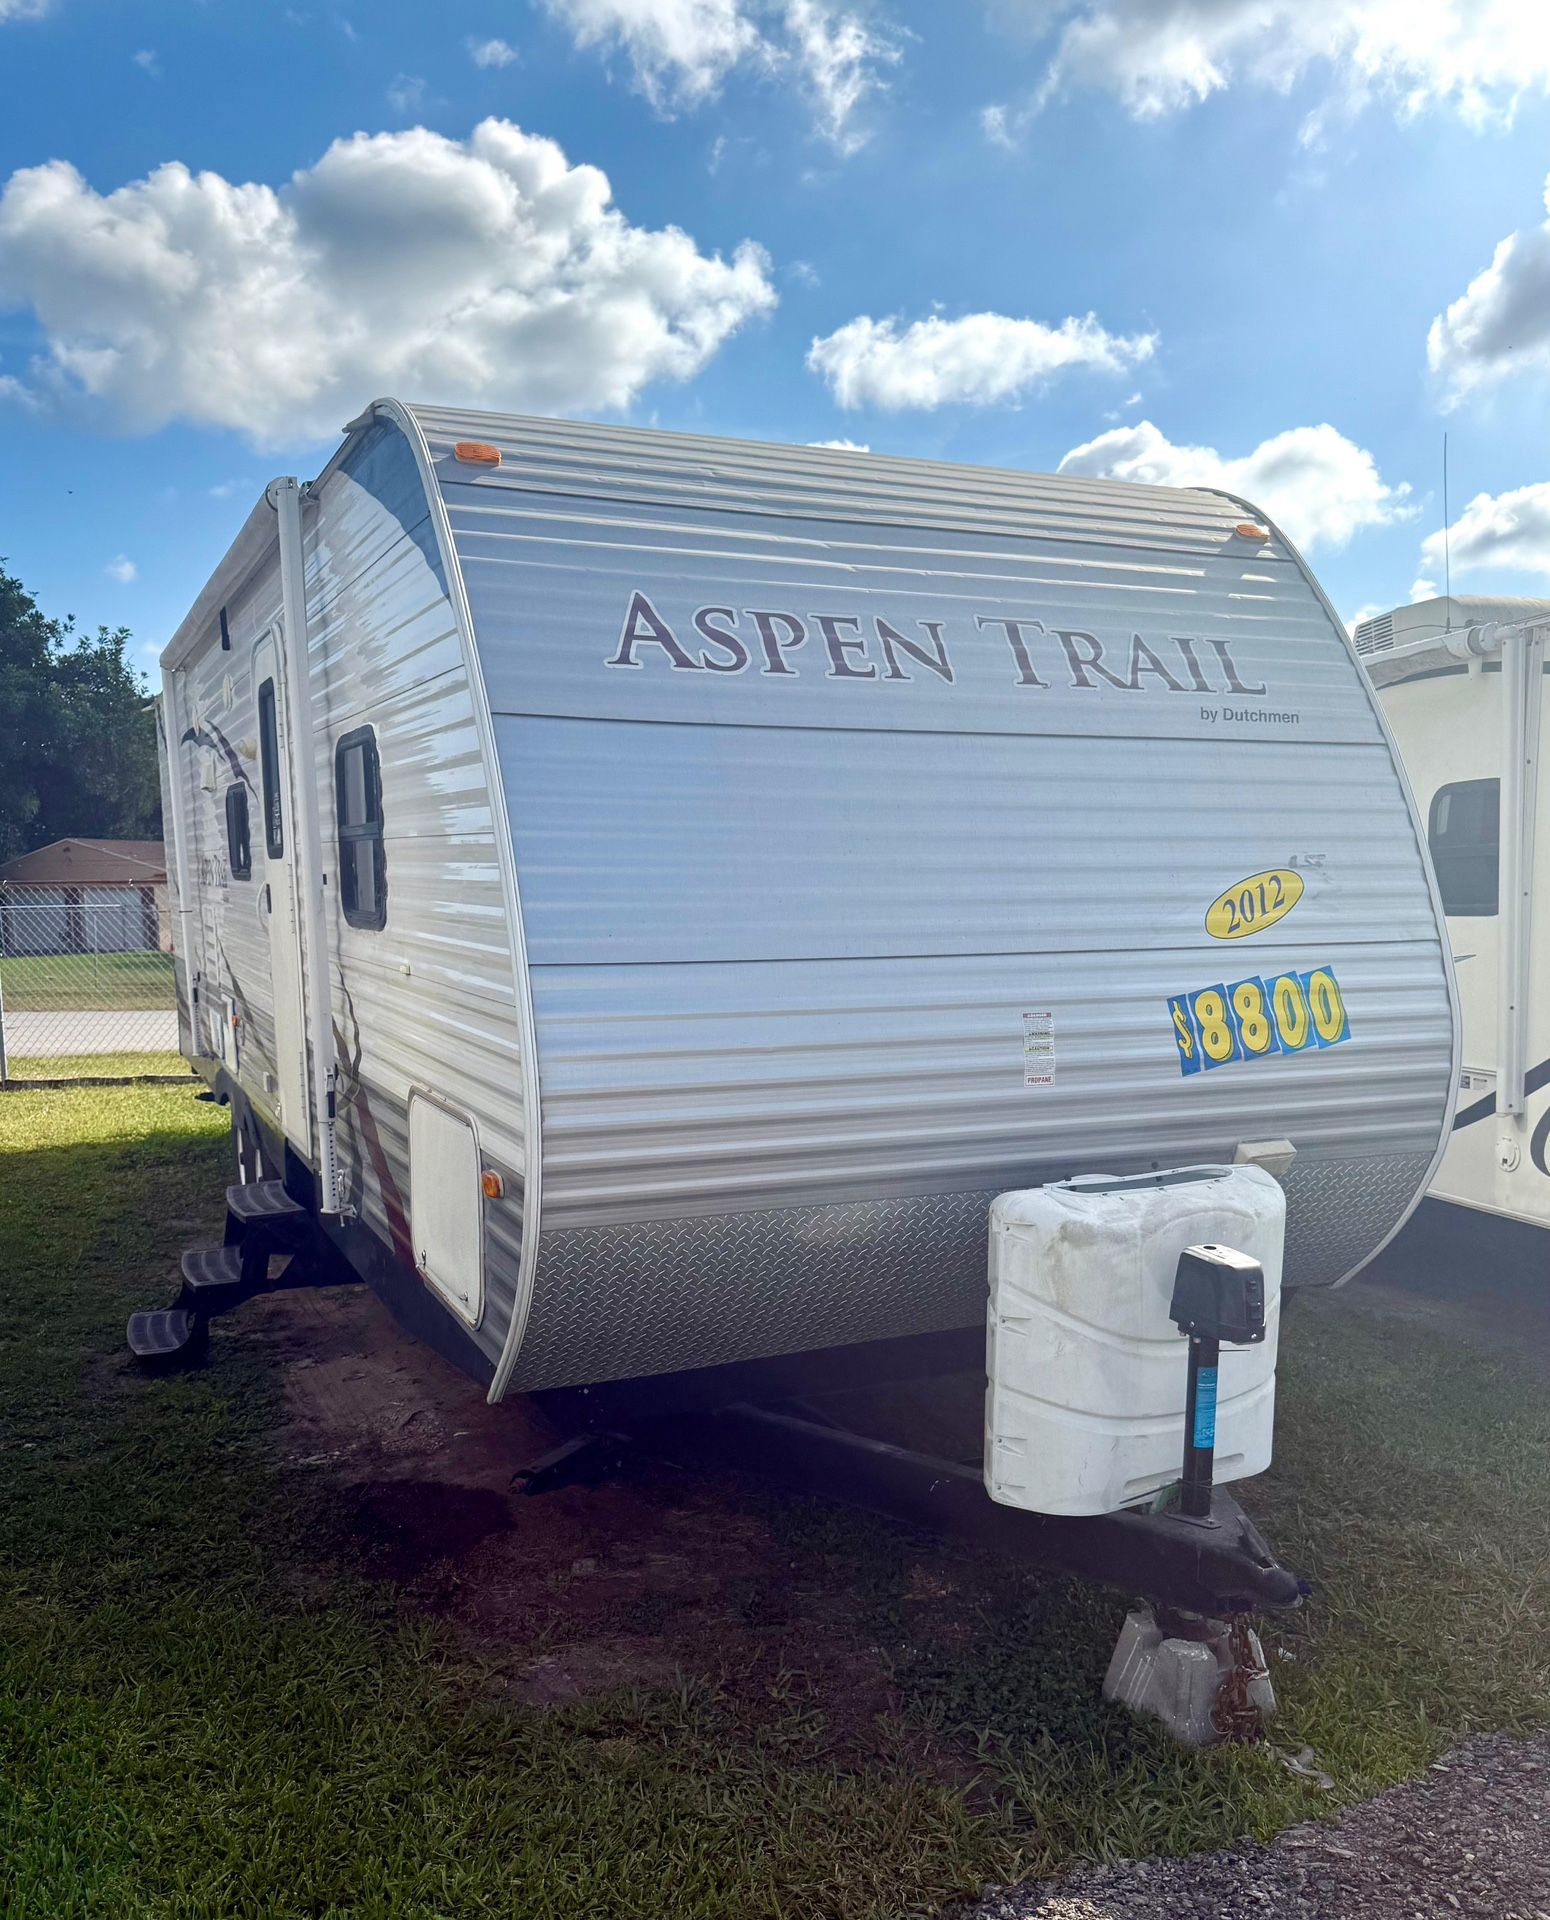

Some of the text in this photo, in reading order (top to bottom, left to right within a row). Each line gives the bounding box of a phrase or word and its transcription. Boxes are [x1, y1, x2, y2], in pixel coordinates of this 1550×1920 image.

[605, 590, 1267, 696] ASPEN TRAIL
[1200, 706, 1300, 724] by Dutchmen
[1222, 875, 1286, 934] 2012
[1171, 969, 1345, 1062] $8800
[1027, 1076, 1052, 1084] PROPANE
